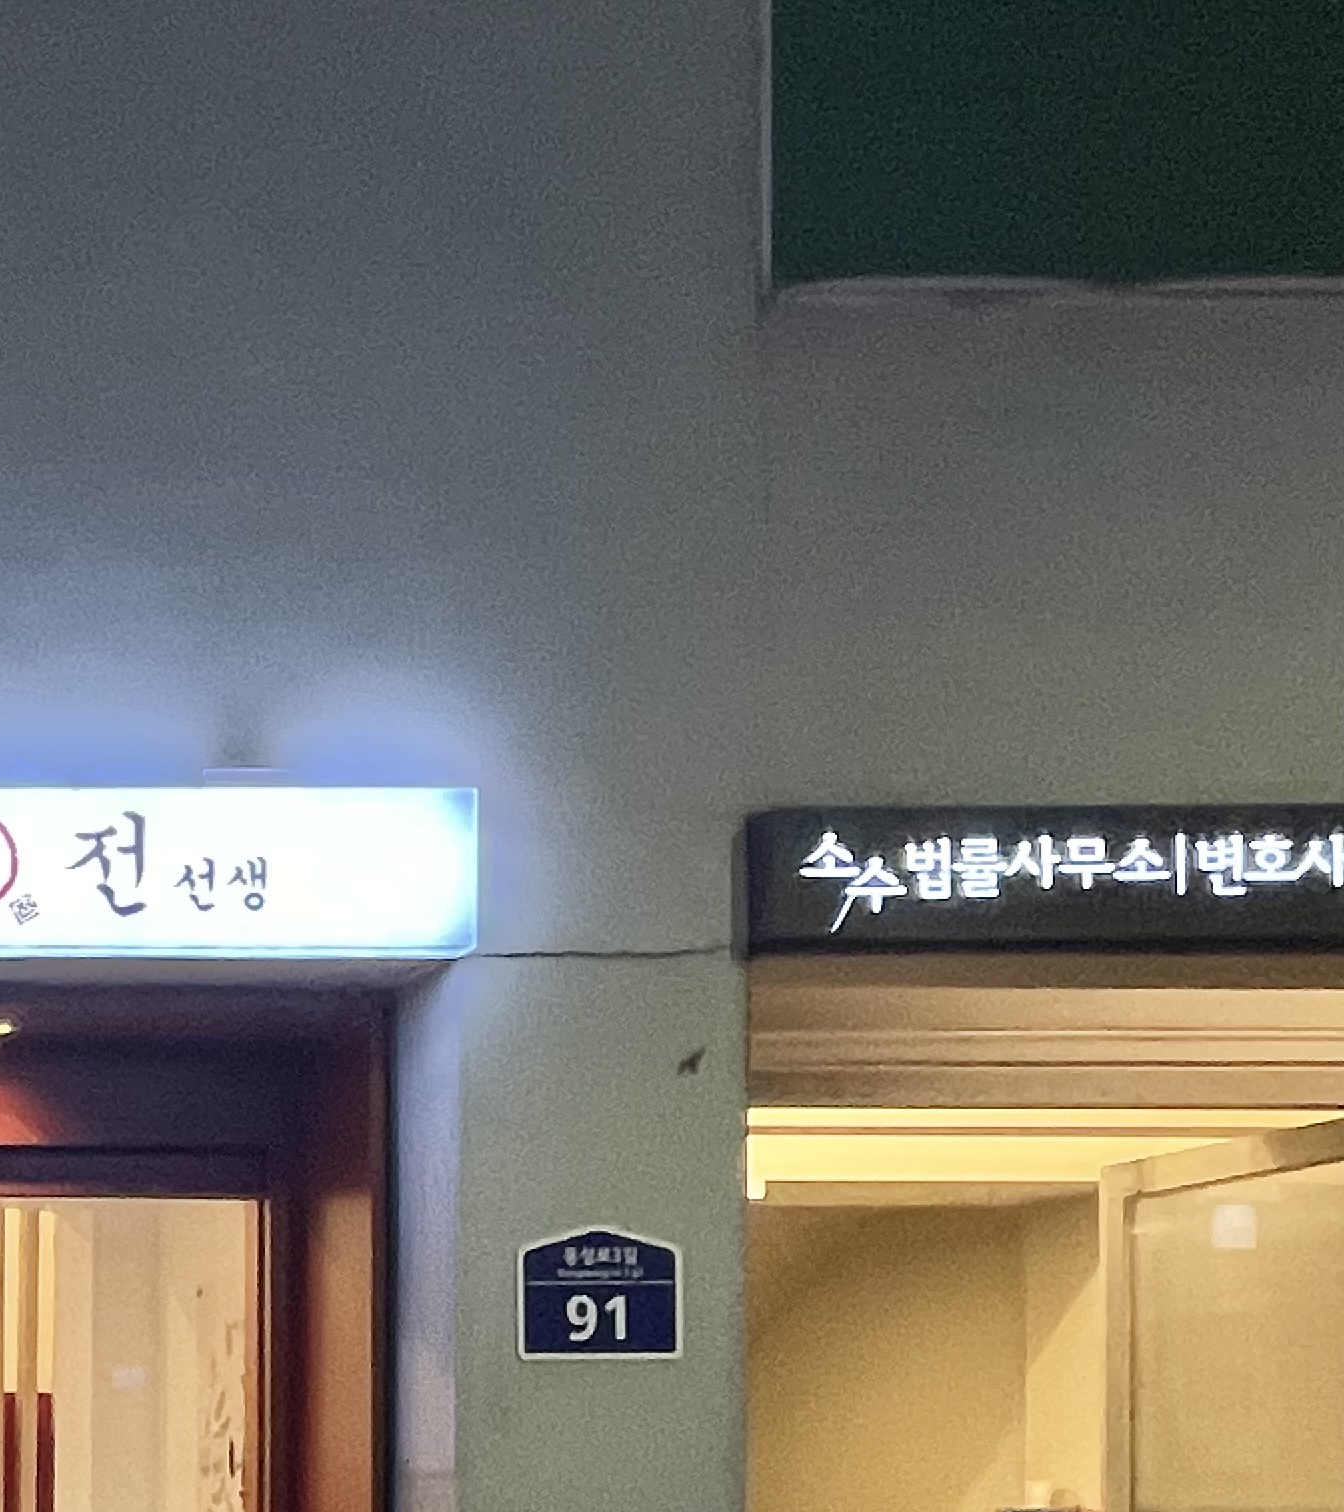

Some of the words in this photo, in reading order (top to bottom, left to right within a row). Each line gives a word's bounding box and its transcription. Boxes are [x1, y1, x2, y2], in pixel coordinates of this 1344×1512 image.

[66, 811, 147, 917] 전
[175, 857, 267, 911] 선생
[567, 1295, 625, 1341] 91
